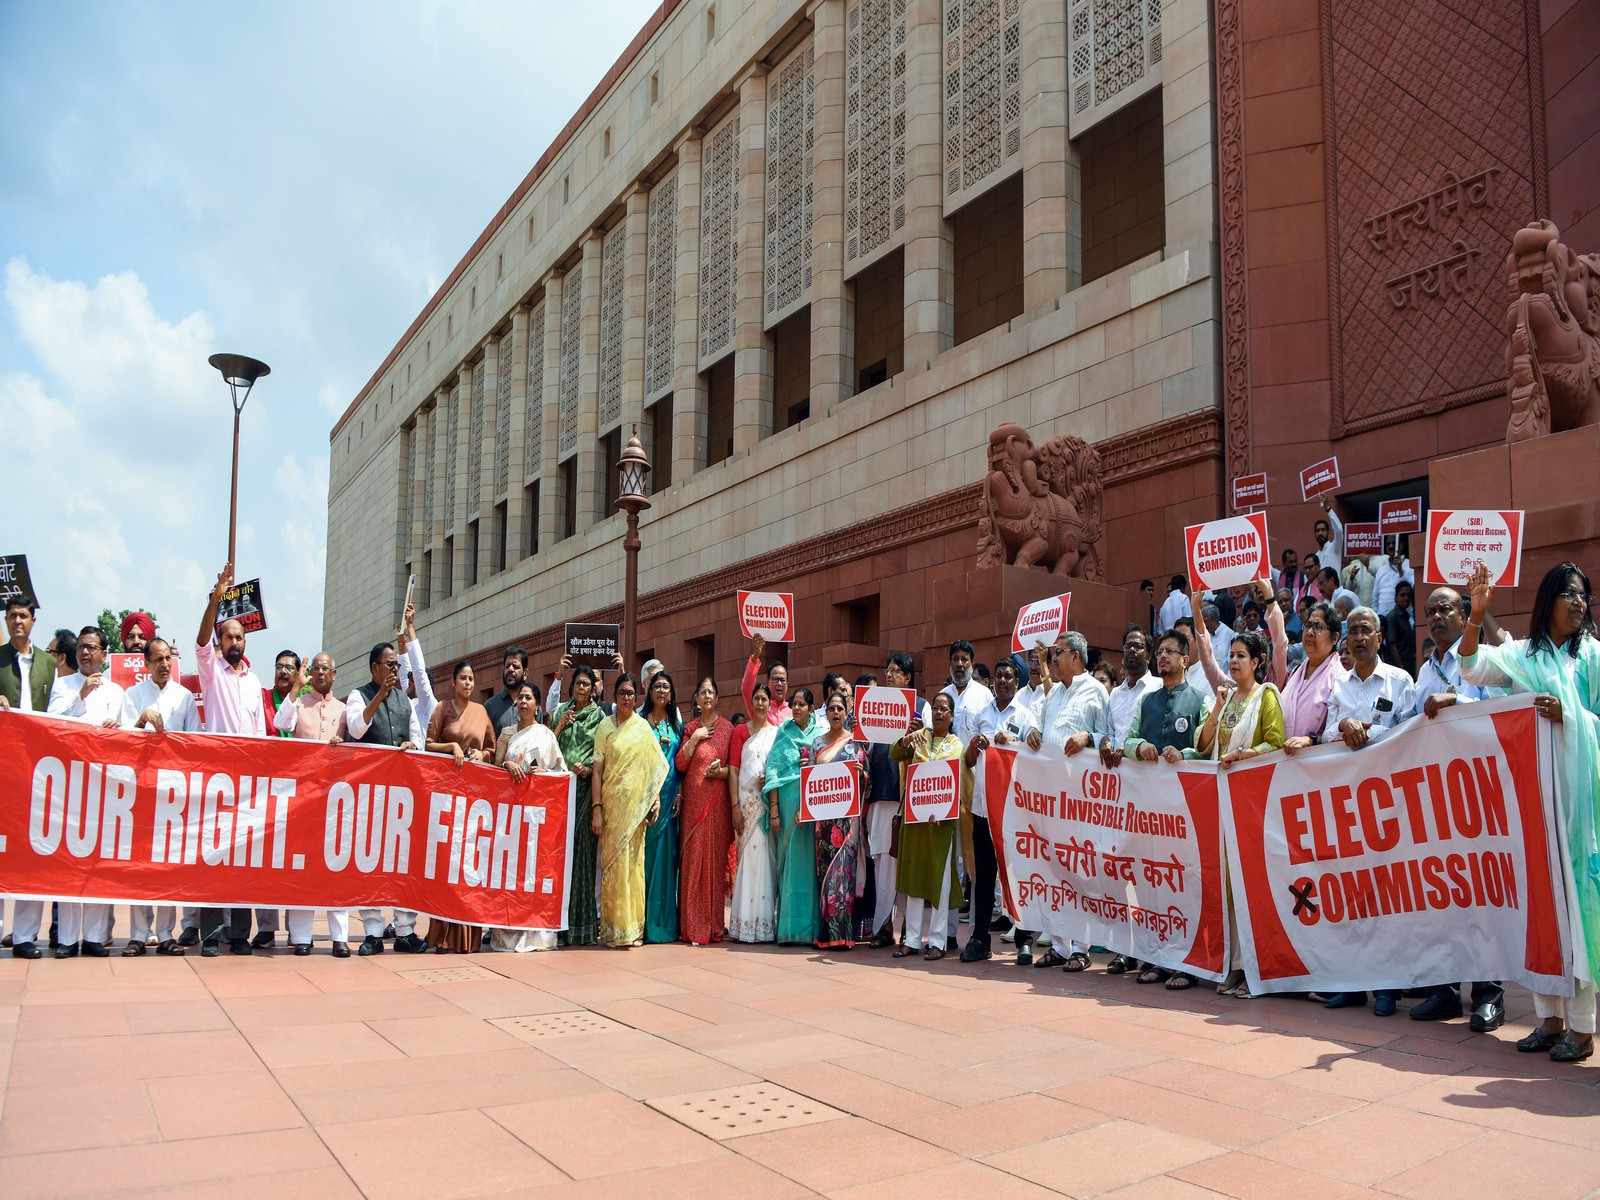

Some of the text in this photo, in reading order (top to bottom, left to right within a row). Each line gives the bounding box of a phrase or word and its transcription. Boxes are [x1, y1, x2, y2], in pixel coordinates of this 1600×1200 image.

[1363, 167, 1500, 253] सत्यमेव
[1385, 239, 1481, 309] जयते
[1442, 527, 1507, 536] SILENT INVISIBLE RIGGING
[1467, 517, 1483, 526] (SIR)
[1197, 532, 1256, 558] ELECTION
[1443, 541, 1503, 552] वोट चोरी बंद करो
[745, 604, 786, 619] ELECTION
[1022, 607, 1061, 627] ELECTION
[862, 701, 907, 717] ELECTION
[808, 775, 850, 794] ELECTION
[912, 775, 952, 793] ELECTION
[1081, 769, 1122, 803] (SIR)
[29, 755, 553, 894] OUR RIGHT. OUR FIGHT.
[1014, 781, 1187, 840] SILENT INVISIBLE RIGGING
[1280, 755, 1509, 866] ELECTION
[1015, 824, 1185, 893] वोट चोरी बंद करो
[1290, 851, 1520, 927] COMMISSION
[1018, 873, 1189, 942] চুপি চুপি ভোটের কারচুপি
